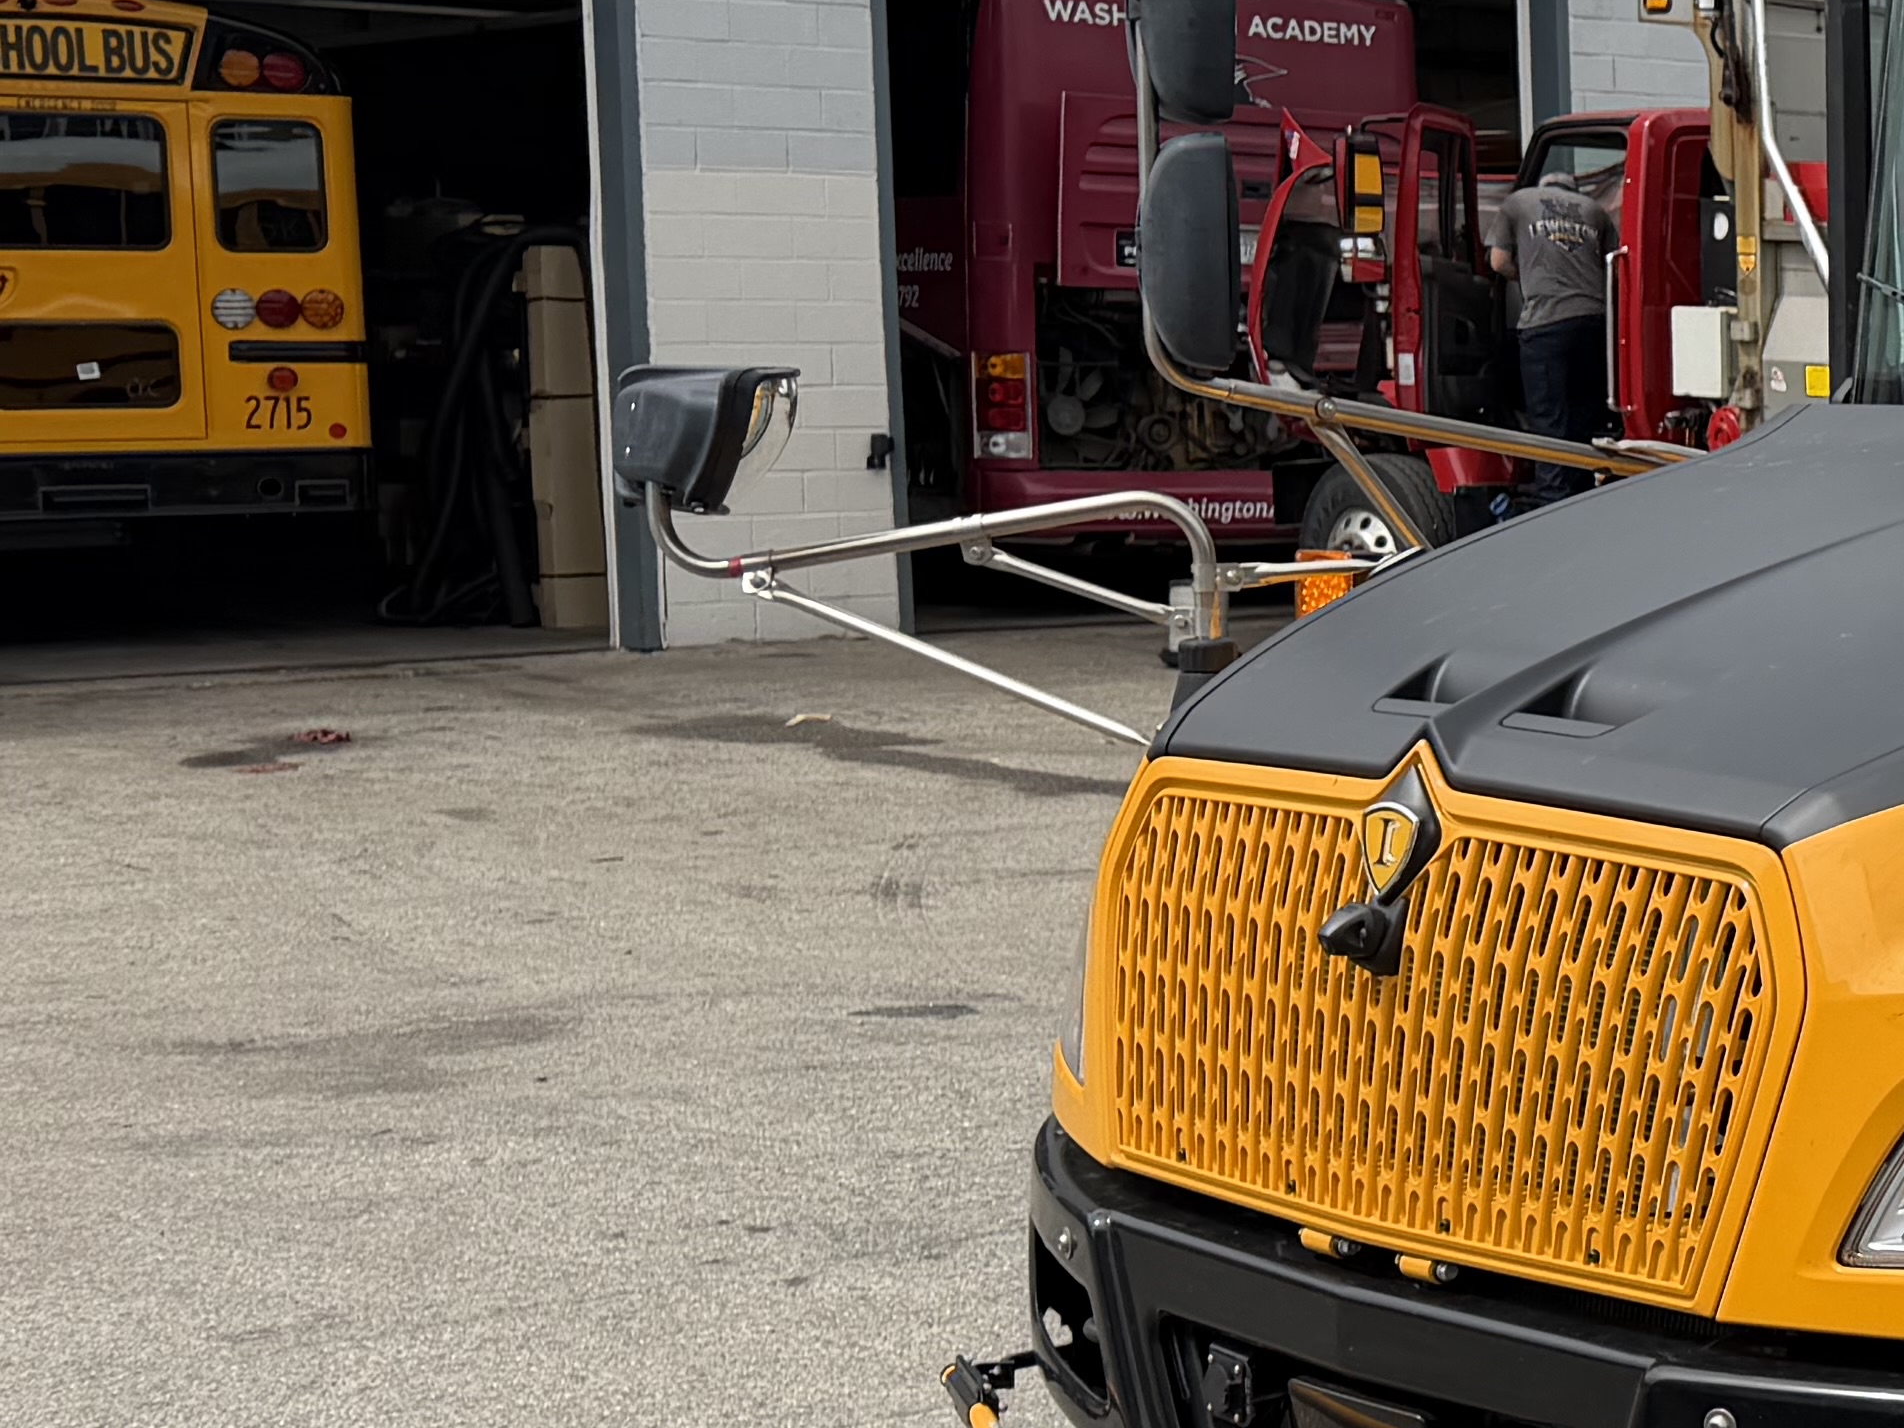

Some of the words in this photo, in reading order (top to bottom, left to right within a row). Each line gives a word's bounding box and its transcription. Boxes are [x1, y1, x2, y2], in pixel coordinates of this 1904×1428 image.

[1248, 15, 1376, 47] ACADEMY
[0, 25, 100, 73] HOOL
[102, 29, 175, 77] BUS
[896, 246, 953, 272] xcellence
[245, 396, 312, 432] 2715
